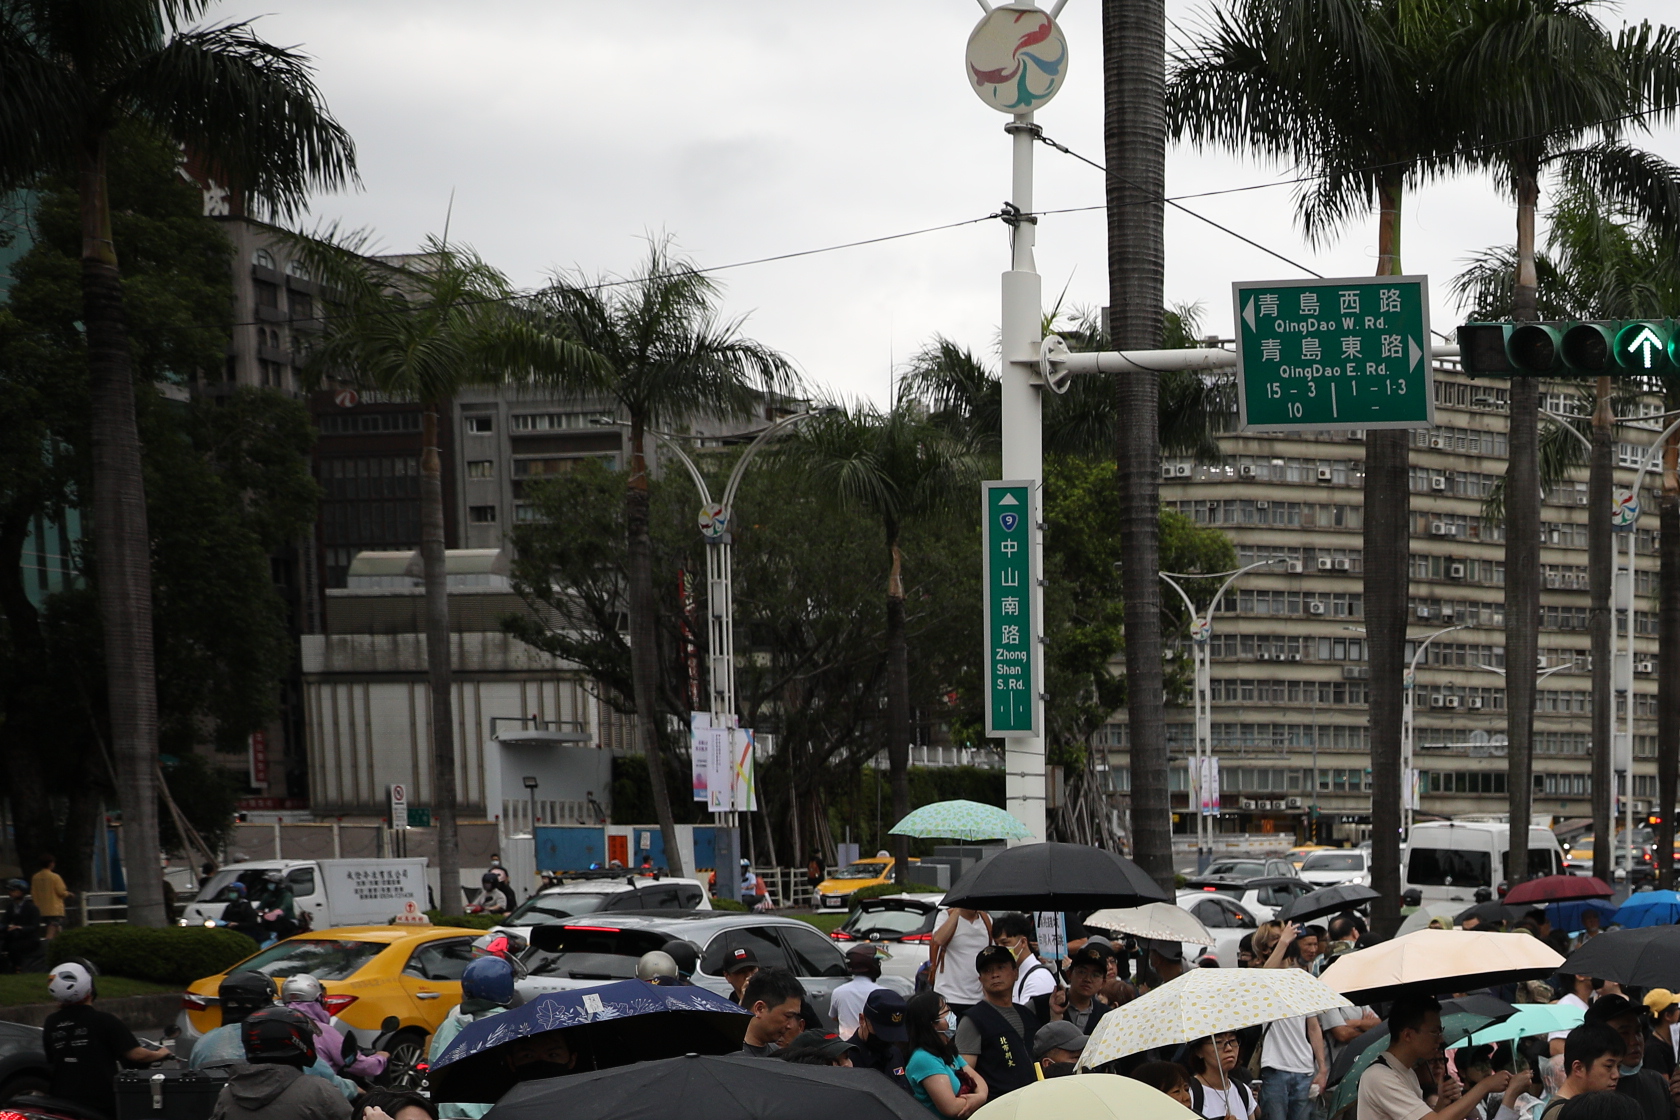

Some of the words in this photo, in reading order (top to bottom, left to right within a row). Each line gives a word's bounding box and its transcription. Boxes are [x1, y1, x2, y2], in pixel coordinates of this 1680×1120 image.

[1258, 288, 1402, 317] 青島西路
[1274, 318, 1336, 335] QingDao
[1342, 317, 1360, 330] W.
[1364, 316, 1389, 330] Rd.
[1260, 333, 1403, 362] 青島東路
[1279, 363, 1341, 381] QingDao
[1346, 363, 1361, 376] E.
[1366, 362, 1390, 375] Rd.
[1287, 402, 1303, 418] 10
[1005, 515, 1012, 525] 9
[1000, 538, 1019, 645] 中山南路
[996, 649, 1027, 663] Zhong
[996, 664, 1021, 675] Shan
[996, 679, 1007, 690] S.
[1008, 679, 1025, 690] Rd.
